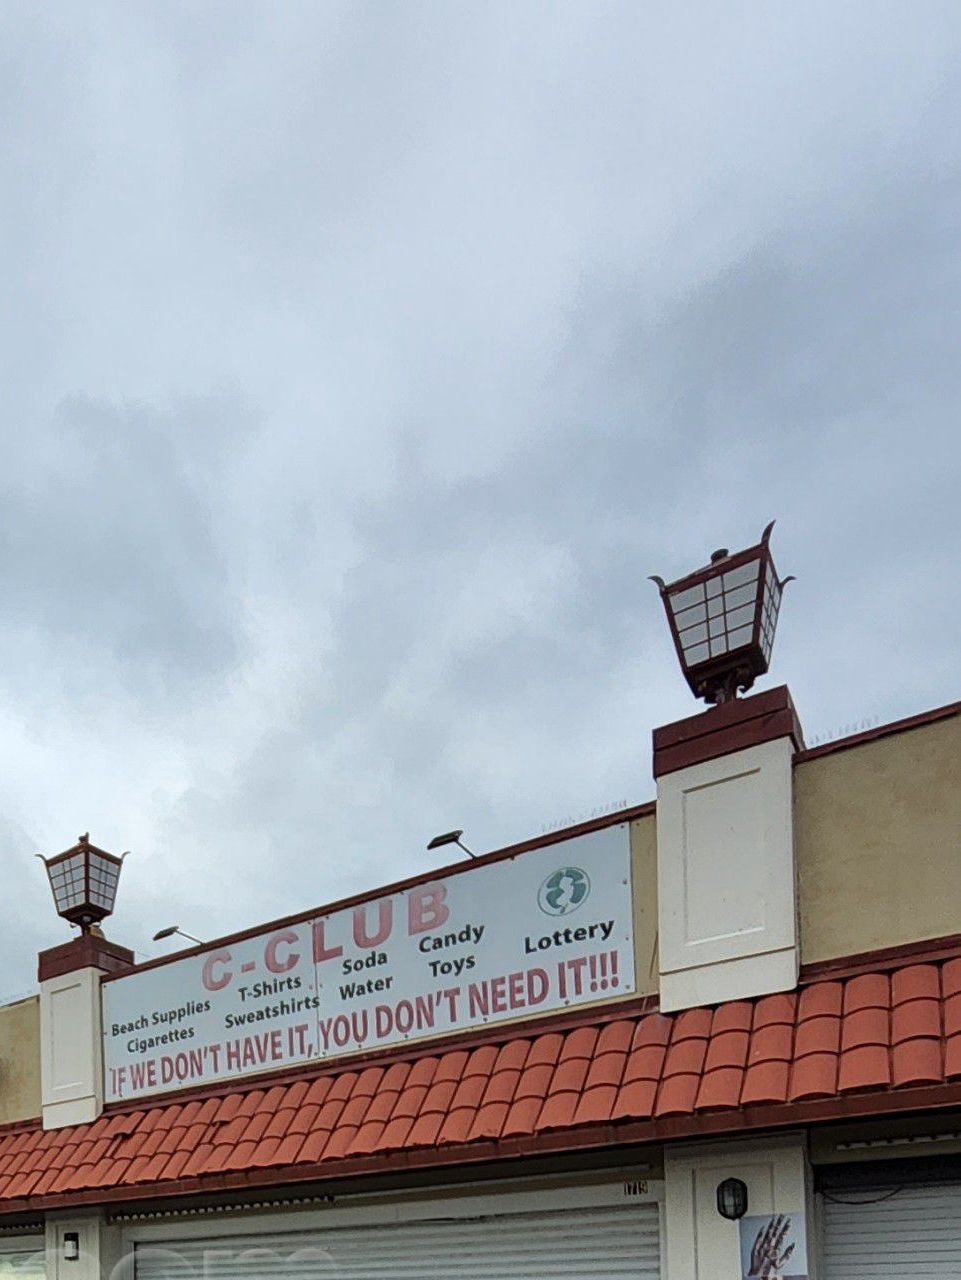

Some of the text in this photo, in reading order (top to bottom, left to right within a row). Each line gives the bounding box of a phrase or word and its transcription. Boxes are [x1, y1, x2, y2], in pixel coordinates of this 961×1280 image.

[202, 882, 450, 992] C-CLUB
[418, 923, 485, 953] Candy
[524, 920, 615, 955] Lottery
[341, 950, 388, 976] Soda
[429, 955, 476, 978] Toys
[238, 976, 302, 1001] T-Shirts
[339, 974, 394, 1000] Water
[111, 1000, 212, 1037] Beach Supplies
[111, 950, 620, 1096] IF WE DON'T HAVE IT, YOU DON'T NEED IT!!!
[224, 995, 320, 1029] Sweatshirts
[126, 1026, 195, 1054] Cigarettes
